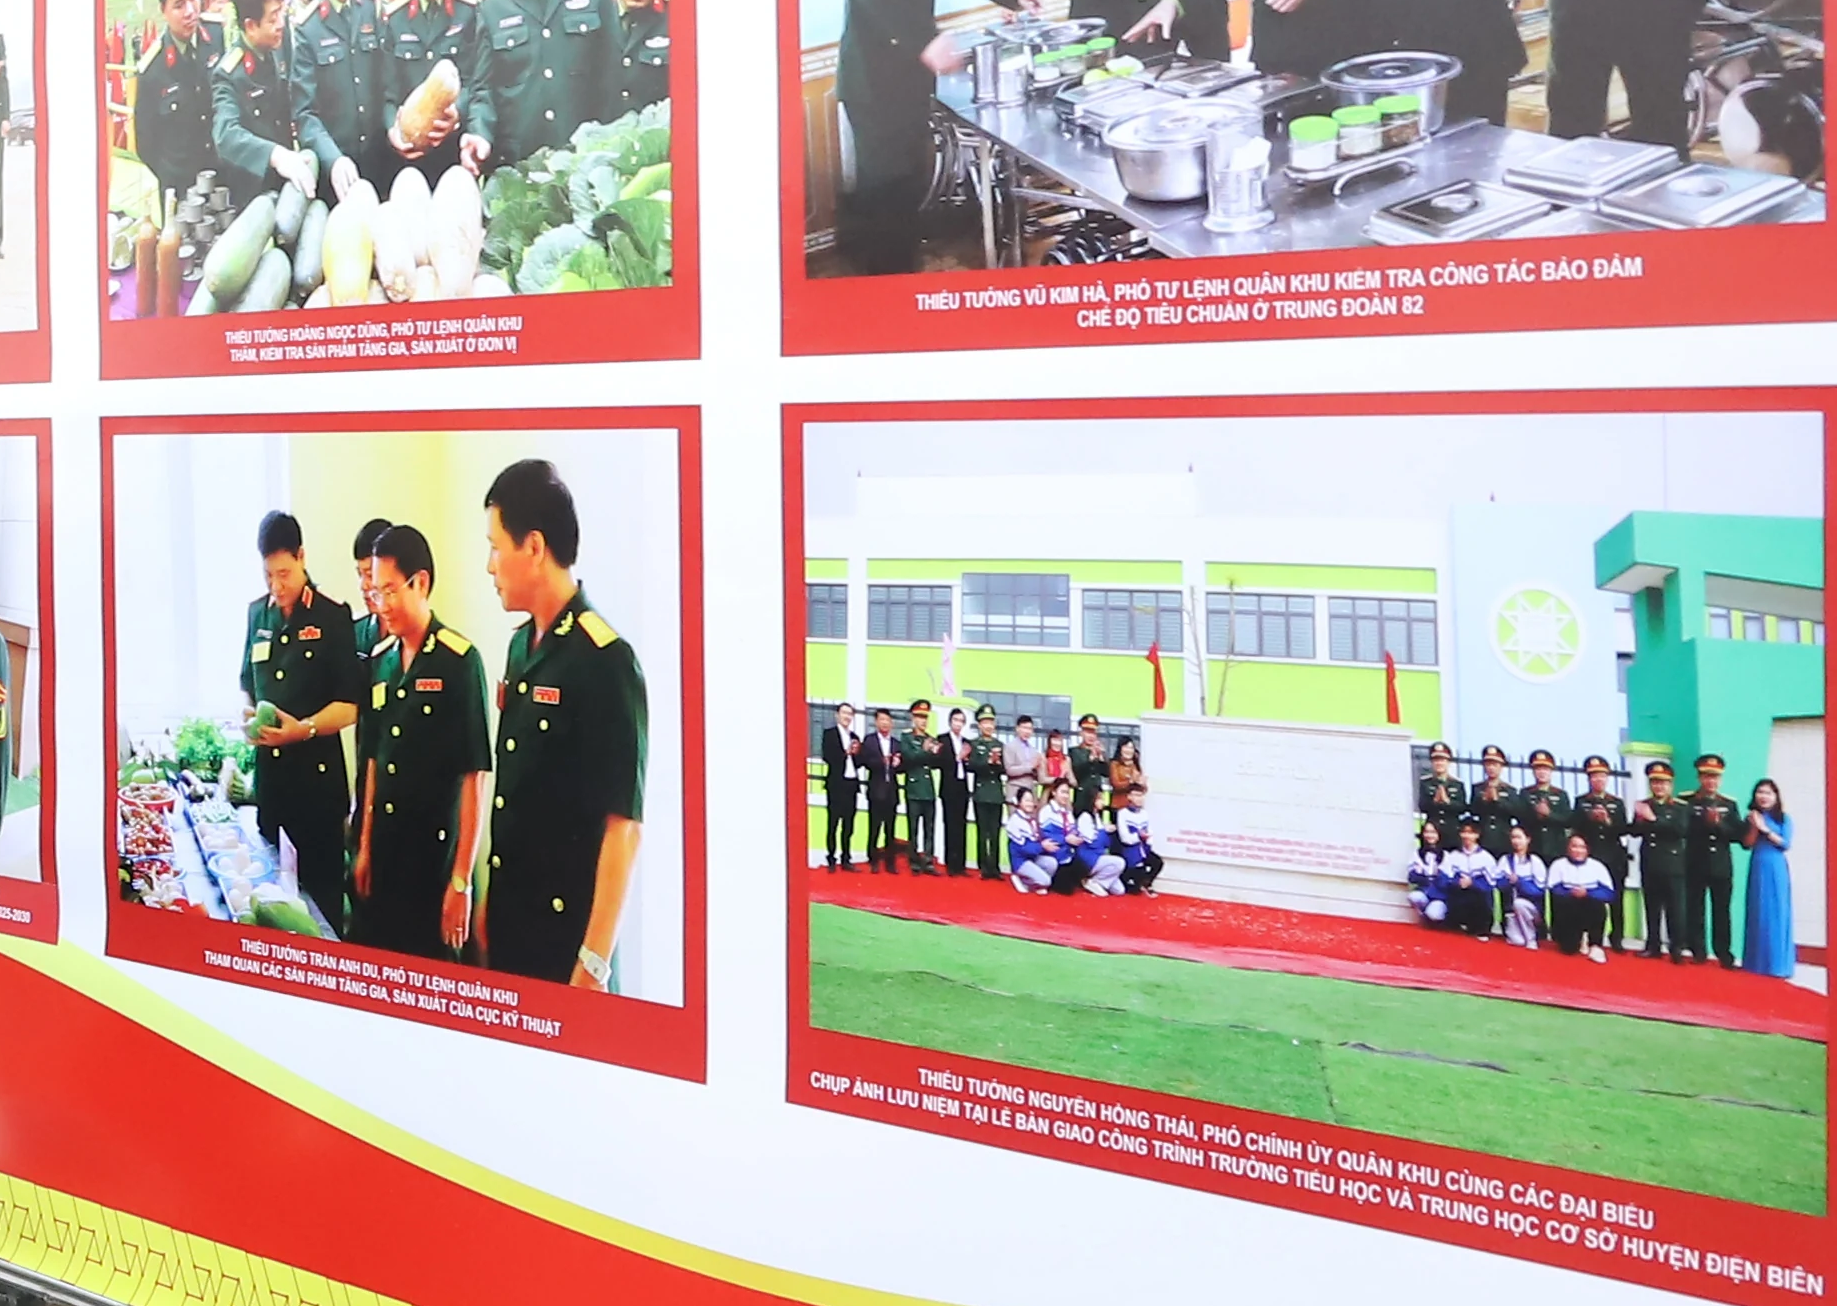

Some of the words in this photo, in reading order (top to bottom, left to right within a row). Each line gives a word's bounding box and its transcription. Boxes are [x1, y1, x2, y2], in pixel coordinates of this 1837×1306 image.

[963, 287, 1021, 308] TƯỚNG
[1024, 285, 1047, 305] VŨ
[1050, 287, 1079, 304] KIM
[1115, 278, 1151, 301] PHÓ
[1155, 281, 1180, 299] TƯ
[1183, 279, 1230, 301] LỆNH
[1234, 272, 1286, 296] QUÂN
[1291, 273, 1330, 292] KHU
[1386, 268, 1425, 287] TRA
[1429, 262, 1488, 286] CÔNG
[1494, 259, 1536, 282] TÁC
[1116, 308, 1141, 329] ĐỘ
[1145, 303, 1182, 324] TIÊU
[1252, 298, 1270, 320] Ở
[1273, 299, 1337, 319] TRUNG
[1341, 293, 1397, 316] ĐOÀN
[1401, 295, 1424, 314] 82
[811, 1072, 850, 1095] CHỤP
[887, 1088, 919, 1107] LƯU
[922, 1094, 960, 1117] NIỆM
[963, 1102, 989, 1125] TẠI
[1016, 1111, 1050, 1134] BÀN
[1054, 1121, 1095, 1143] GIAO
[1098, 1128, 1148, 1155] CÔNG
[1153, 1140, 1204, 1166] TRÌNH
[1208, 1152, 1289, 1184] TRƯỜNG
[1340, 1179, 1382, 1204] HỌC
[1386, 1186, 1414, 1210] VÀ
[1419, 1194, 1489, 1225] TRUNG
[1494, 1210, 1539, 1237] HỌC
[1545, 1221, 1580, 1243] CƠ
[1584, 1227, 1618, 1251] SỞ
[1623, 1236, 1699, 1270] HUYỆN
[1705, 1253, 1760, 1283] ĐIỆN
[1767, 1266, 1824, 1295] BIÊN
[966, 1078, 1025, 1104] TƯỚNG
[1028, 1090, 1096, 1118] NGUYỄN
[1154, 1114, 1198, 1141] THÁI,
[1203, 1124, 1241, 1147] PHÓ
[1245, 1133, 1302, 1159] CHÍNH
[1337, 1151, 1392, 1177] QUÂN
[1398, 1162, 1440, 1186] KHU
[1445, 1169, 1504, 1199] CÙNG
[1509, 1183, 1554, 1209] CÁC
[1560, 1194, 1597, 1221] ĐẠI
